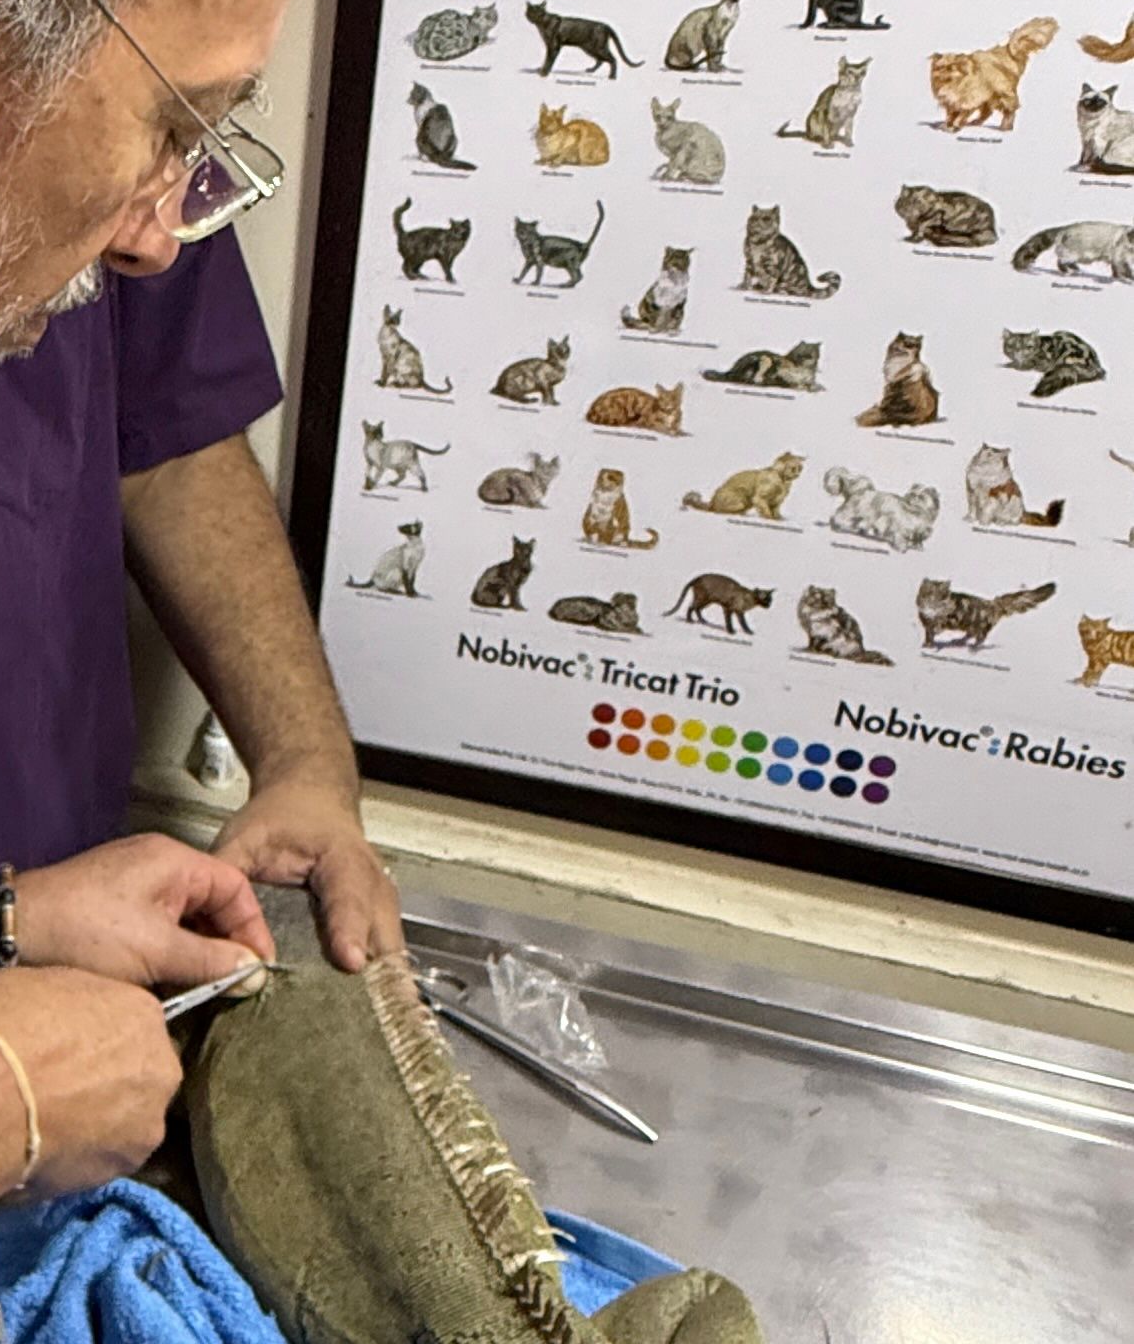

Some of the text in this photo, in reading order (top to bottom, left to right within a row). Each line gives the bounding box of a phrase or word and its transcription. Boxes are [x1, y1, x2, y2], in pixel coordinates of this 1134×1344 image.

[600, 657, 679, 695] Tricat
[685, 672, 740, 707] Trio
[1004, 731, 1127, 780] Rabies
